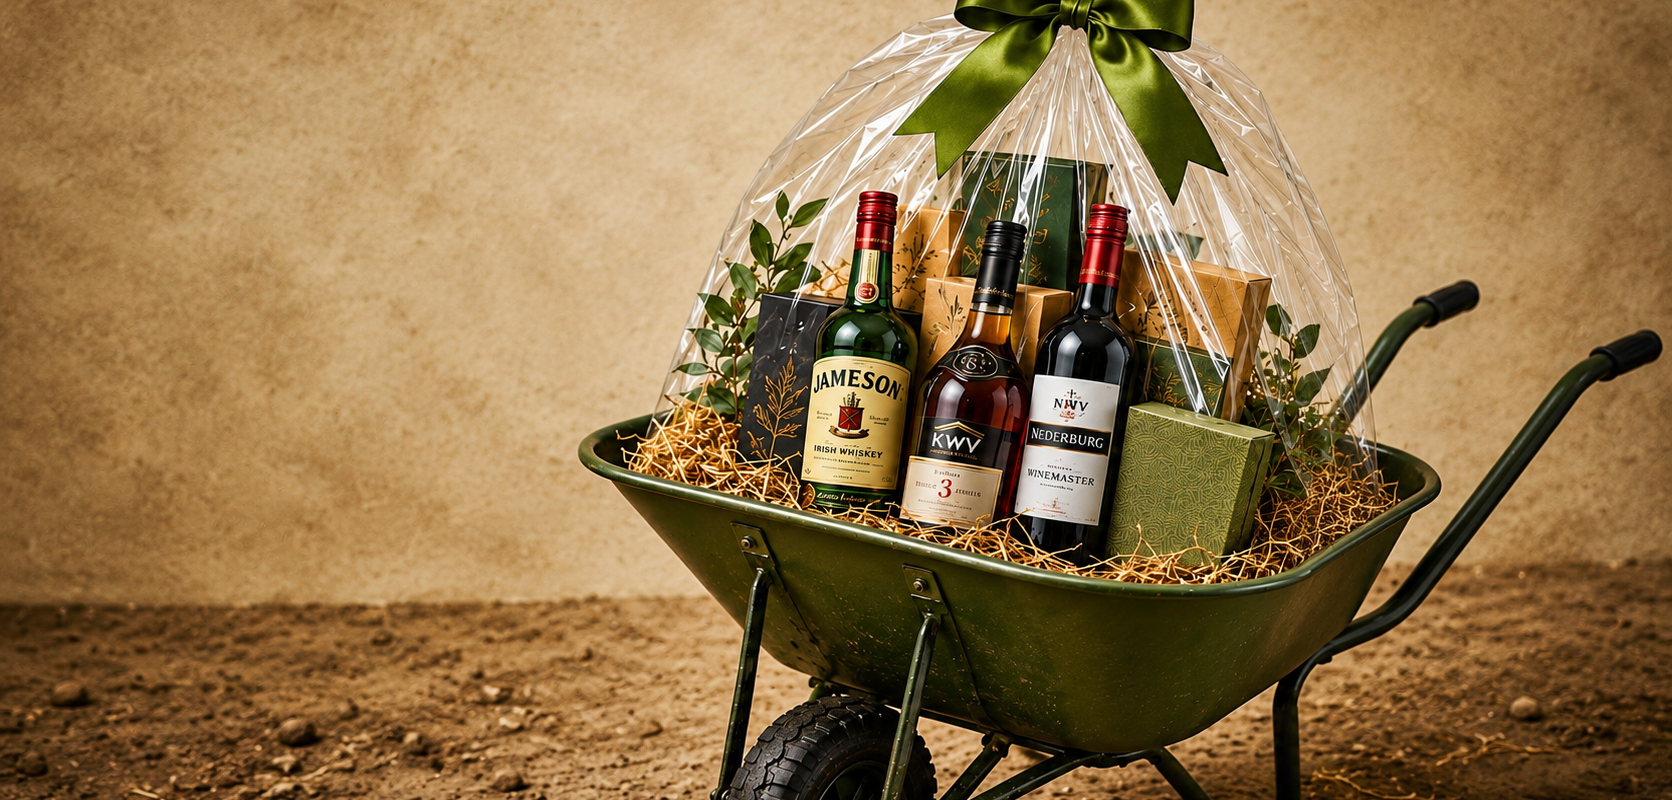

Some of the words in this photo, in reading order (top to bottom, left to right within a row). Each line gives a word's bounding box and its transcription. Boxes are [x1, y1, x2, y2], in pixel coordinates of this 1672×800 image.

[813, 369, 902, 400] JAMESON
[931, 432, 982, 454] KWV
[1031, 427, 1104, 449] NEDERBURG
[813, 444, 837, 454] IRISH
[839, 447, 883, 459] WHISKEY
[937, 478, 952, 498] 3
[1027, 468, 1095, 487] WINEMASTER
